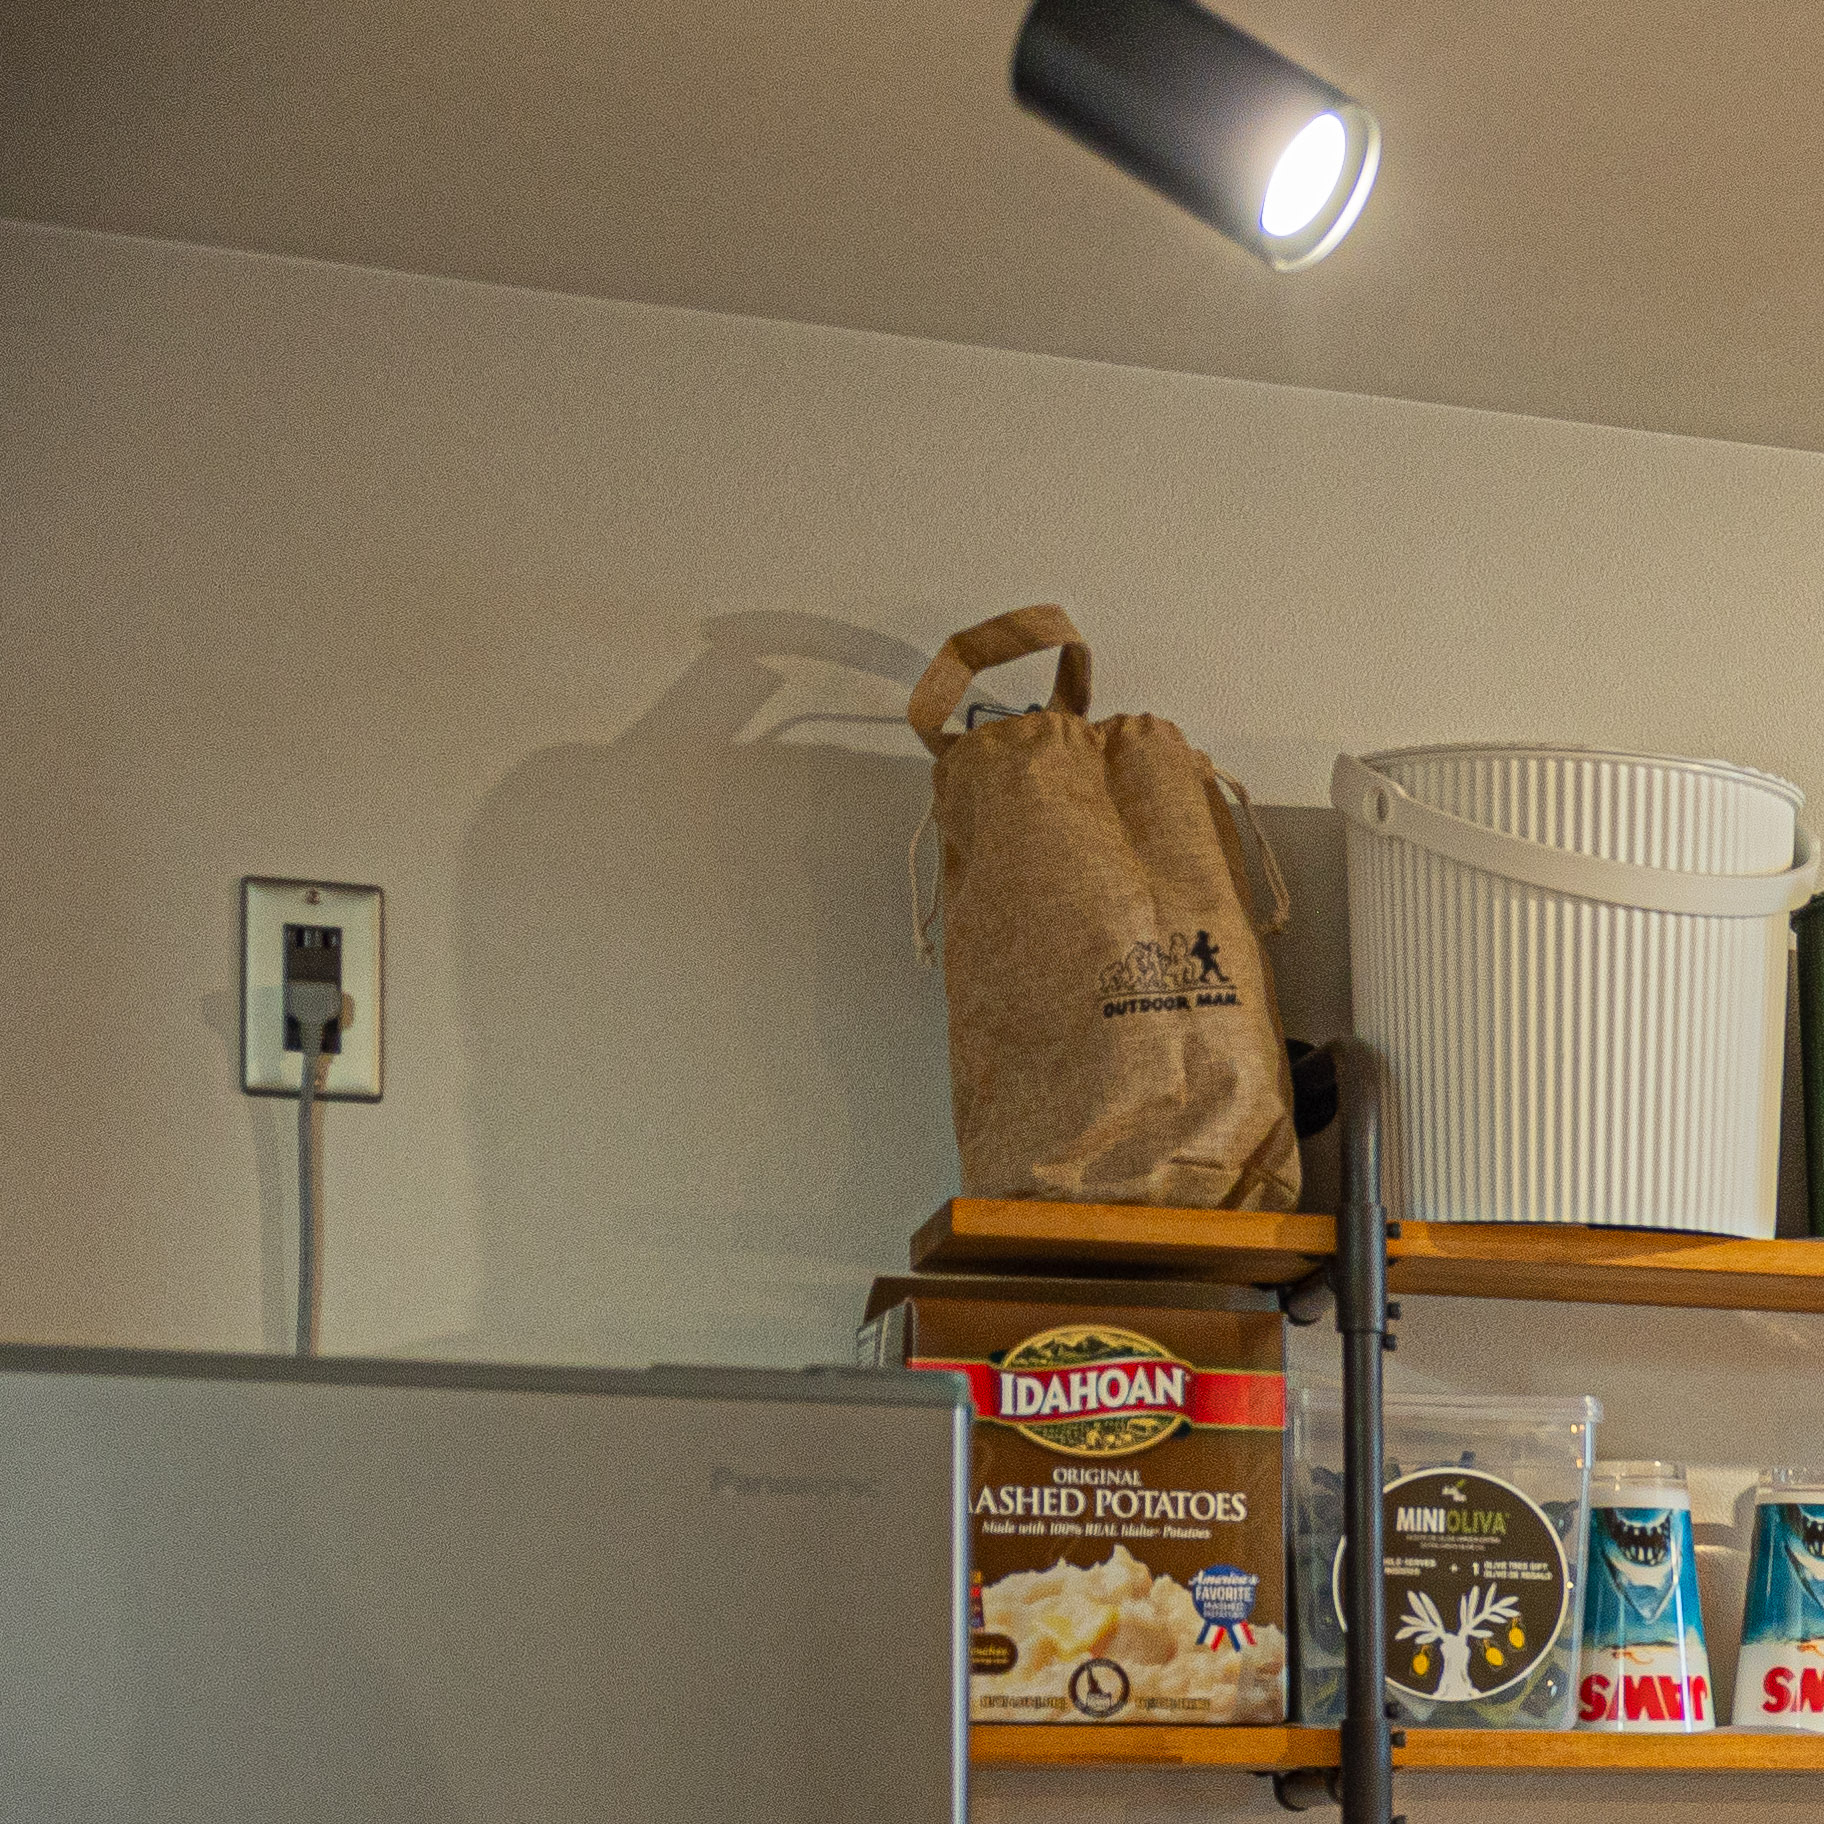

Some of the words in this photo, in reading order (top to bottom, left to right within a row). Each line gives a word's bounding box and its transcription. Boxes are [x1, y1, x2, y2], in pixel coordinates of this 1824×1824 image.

[1103, 996, 1191, 1018] OUTDOOR
[1052, 1467, 1143, 1486] ORIGINAL
[1095, 1489, 1248, 1522] POTATOES
[1195, 1586, 1253, 1601] FAVORITE
[1579, 1673, 1707, 1722] JAWS
